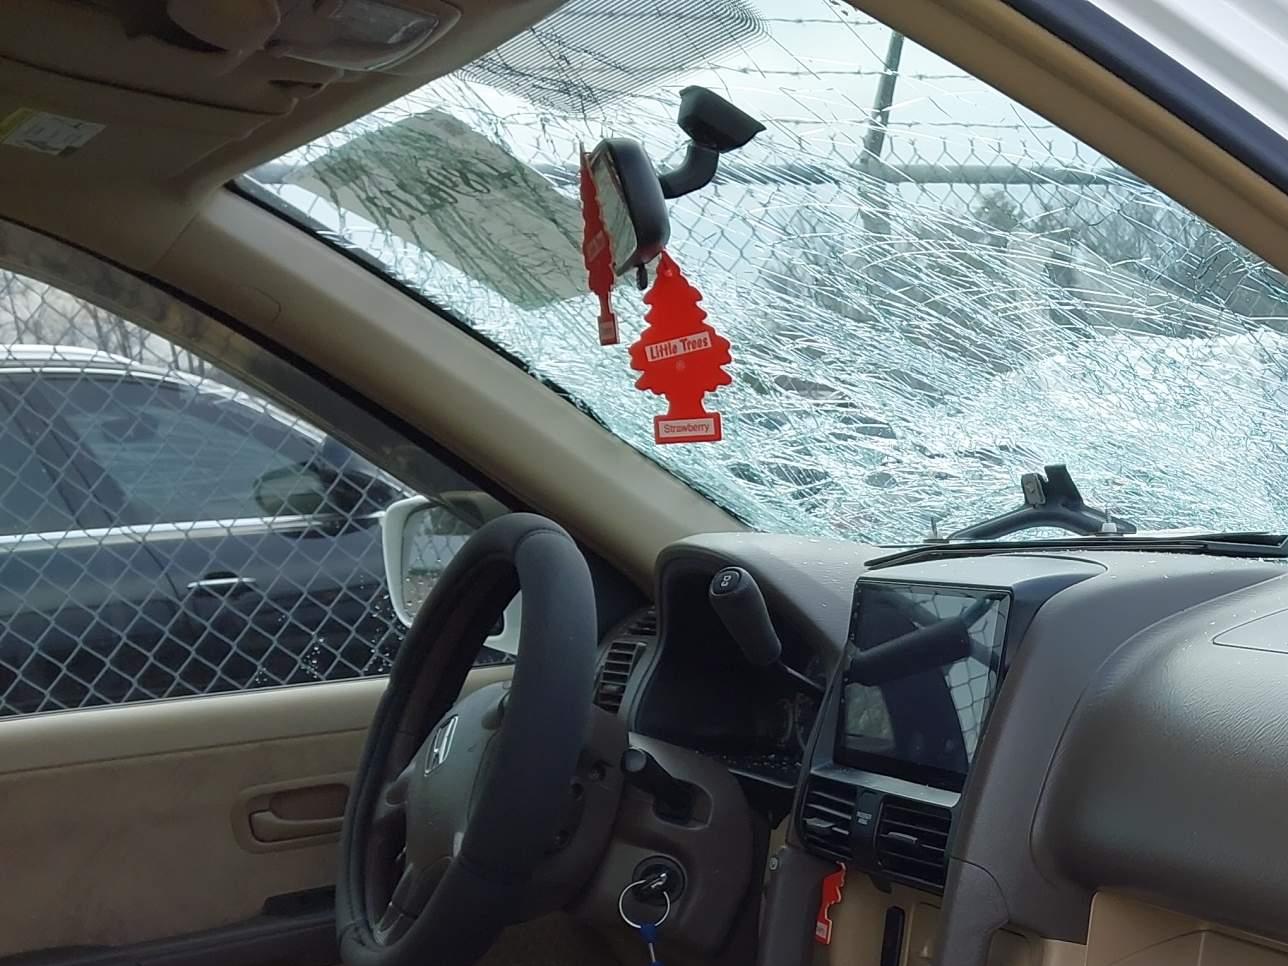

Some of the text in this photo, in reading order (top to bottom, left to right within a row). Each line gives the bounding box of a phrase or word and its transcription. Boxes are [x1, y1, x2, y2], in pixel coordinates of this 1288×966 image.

[650, 336, 709, 360] Little Trees
[663, 422, 710, 434] Strawberry
